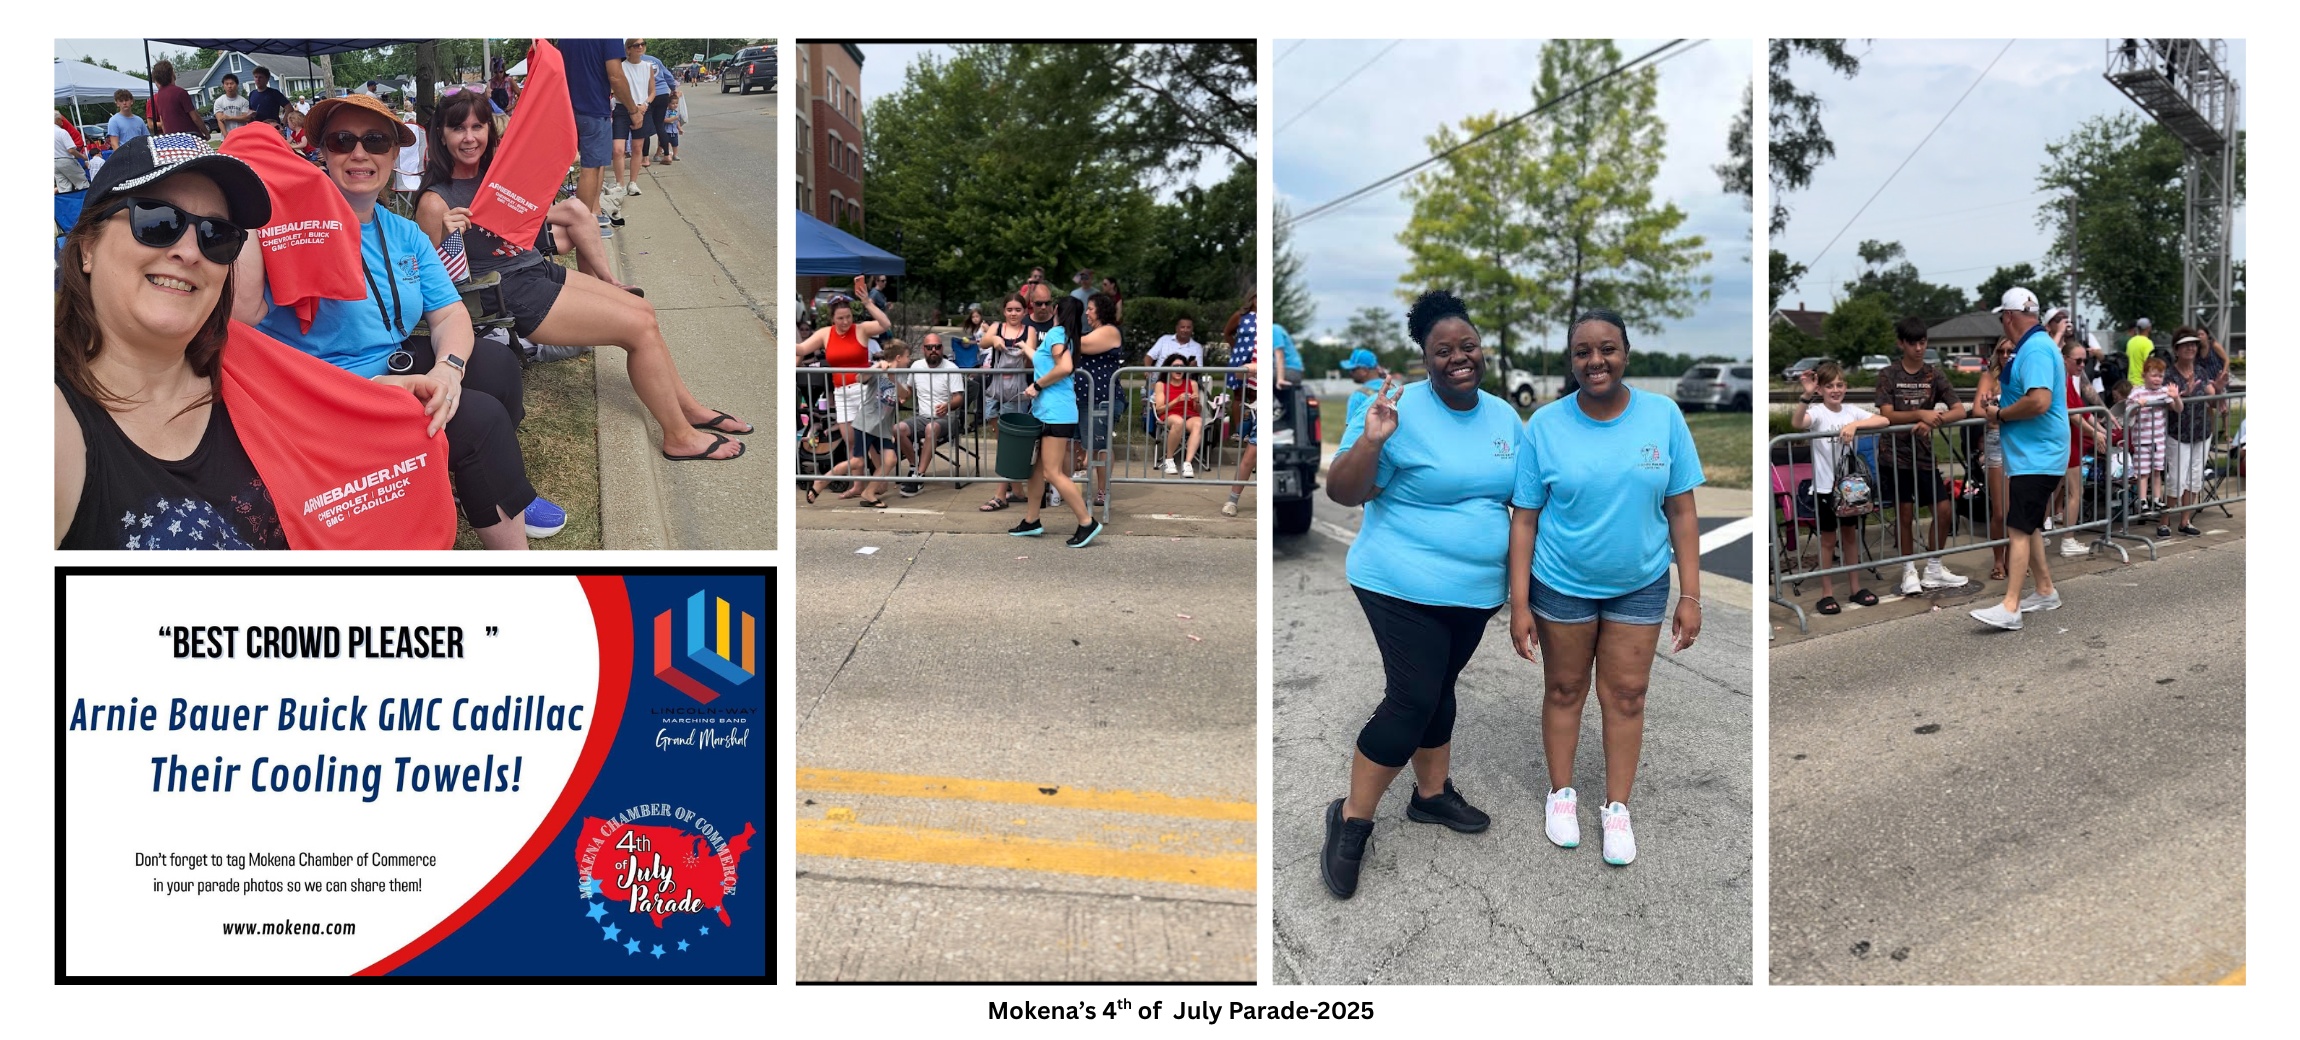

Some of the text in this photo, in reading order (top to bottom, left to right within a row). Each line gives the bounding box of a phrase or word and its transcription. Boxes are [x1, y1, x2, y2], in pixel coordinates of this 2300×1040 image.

[256, 220, 343, 239] RNIEBAUER.NET
[262, 231, 330, 247] CHEVROLET BUICK
[271, 238, 325, 252] GMC CADILLAC
[303, 453, 428, 516] ARNIEBAUER.NET
[318, 477, 411, 522] CHEVROLET BUICK
[326, 489, 406, 528] GMC CADILLAC
[247, 626, 339, 658] CROWD
[349, 626, 463, 658] PLEASER
[70, 696, 584, 731] Arnie Bauer Buick GMC Cadillac
[651, 707, 757, 715] LINCOLN-WAY
[656, 727, 750, 751] Grand Marshal
[152, 755, 522, 802] Their Cooling Towels!
[1553, 801, 1577, 815] NIKE
[578, 803, 737, 899] MOKENA CHAMBER OF COMMERCE
[615, 830, 651, 853] 4th
[135, 852, 436, 871] Don’t forget to tag Mokena Chamber of Commerce
[615, 852, 676, 893] of July
[153, 878, 422, 896] in your parade photos so we can share them!
[629, 883, 705, 914] Parade
[222, 919, 356, 936] www.mokena.com
